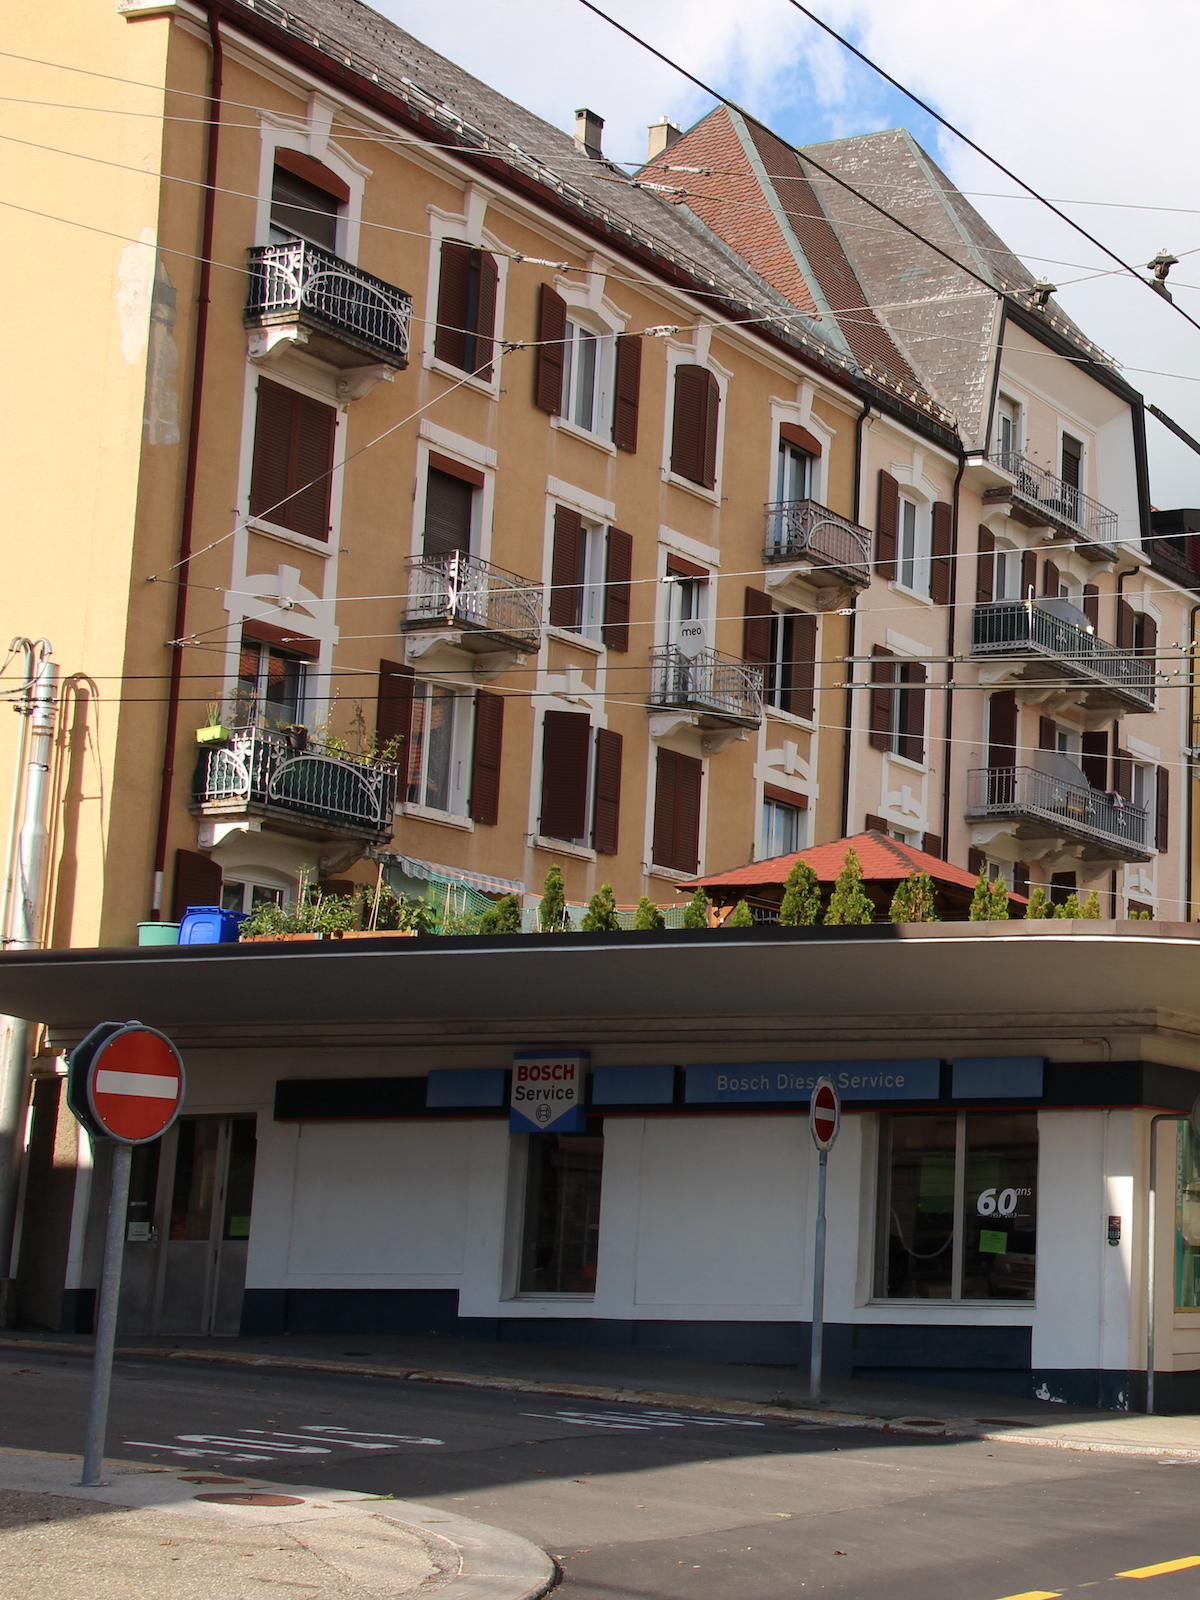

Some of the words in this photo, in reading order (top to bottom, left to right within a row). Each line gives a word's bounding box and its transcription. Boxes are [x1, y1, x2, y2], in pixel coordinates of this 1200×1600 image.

[681, 627, 702, 637] meo
[517, 1063, 575, 1082] BOSCH
[717, 1074, 770, 1091] Bosch
[776, 1073, 831, 1090] Dies
[838, 1072, 905, 1089] Service
[514, 1084, 575, 1101] Service
[976, 1187, 1018, 1216] 60
[1014, 1187, 1032, 1196] ans
